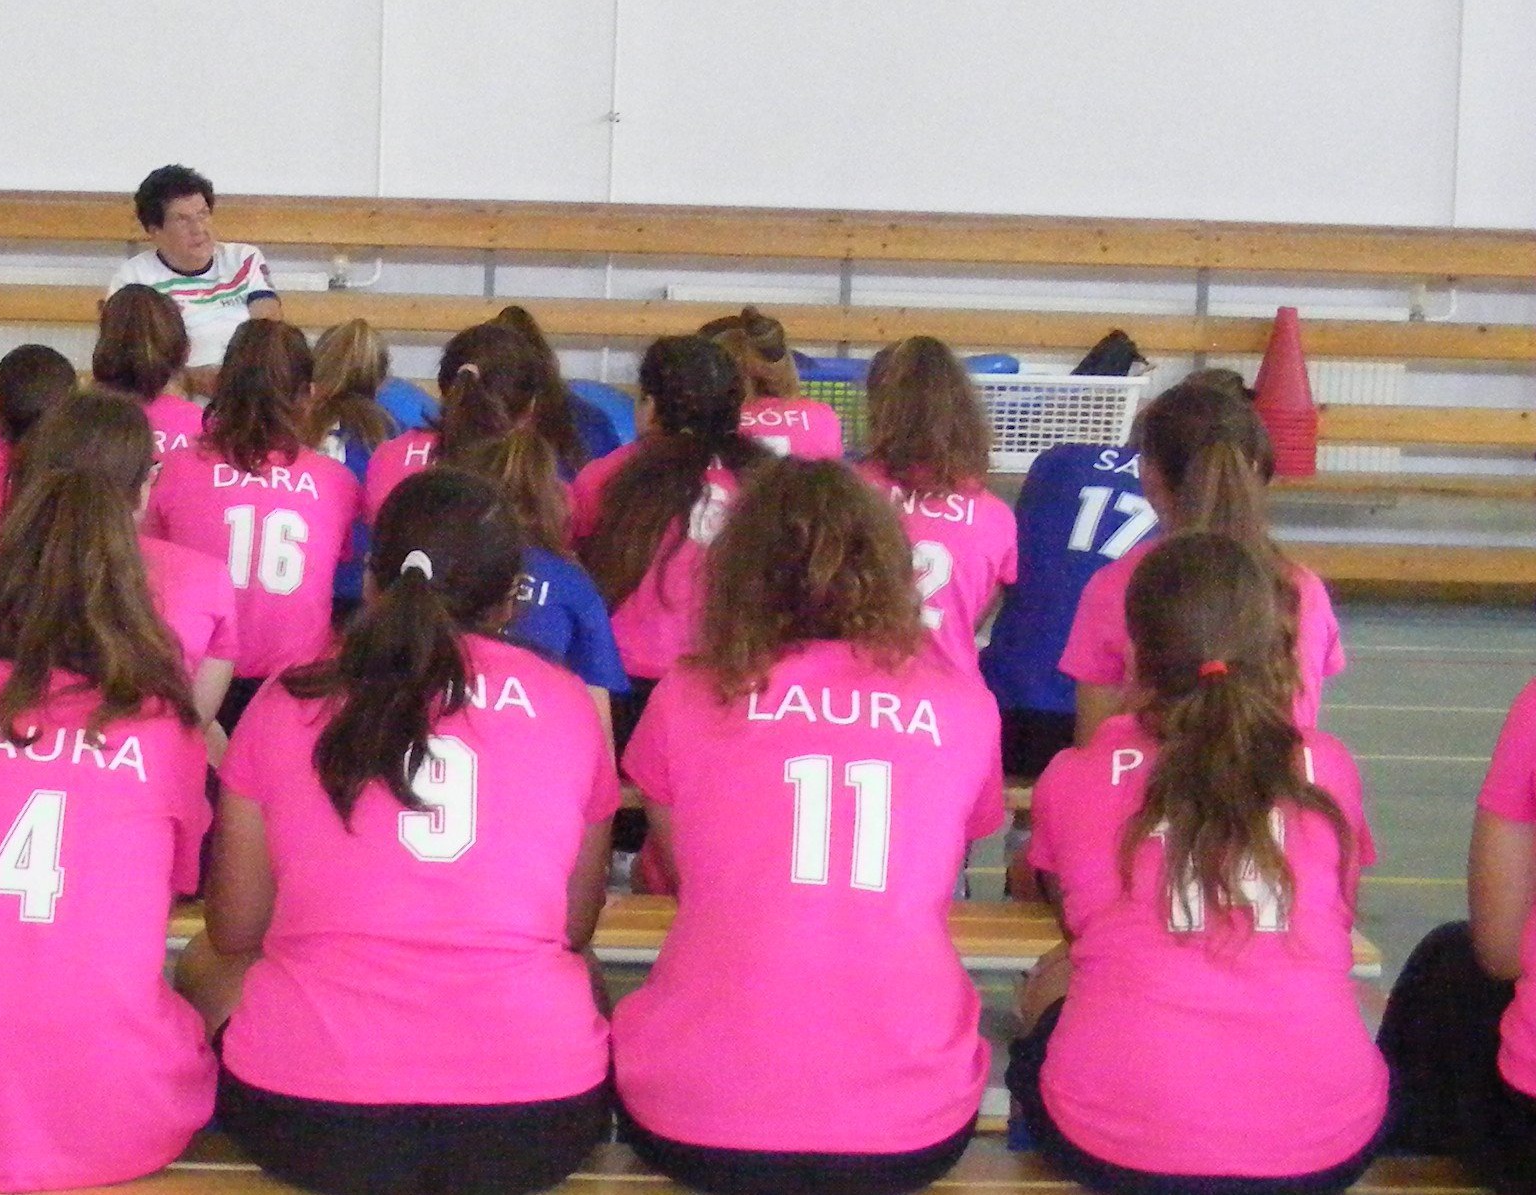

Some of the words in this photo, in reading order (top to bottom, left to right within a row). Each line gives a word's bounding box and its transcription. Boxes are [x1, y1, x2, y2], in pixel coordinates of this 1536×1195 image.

[214, 464, 319, 500] DARA
[1067, 486, 1158, 559] 17
[224, 504, 308, 595] 16
[747, 684, 942, 747] LAURA
[398, 734, 478, 863] 9
[784, 754, 892, 892] 11
